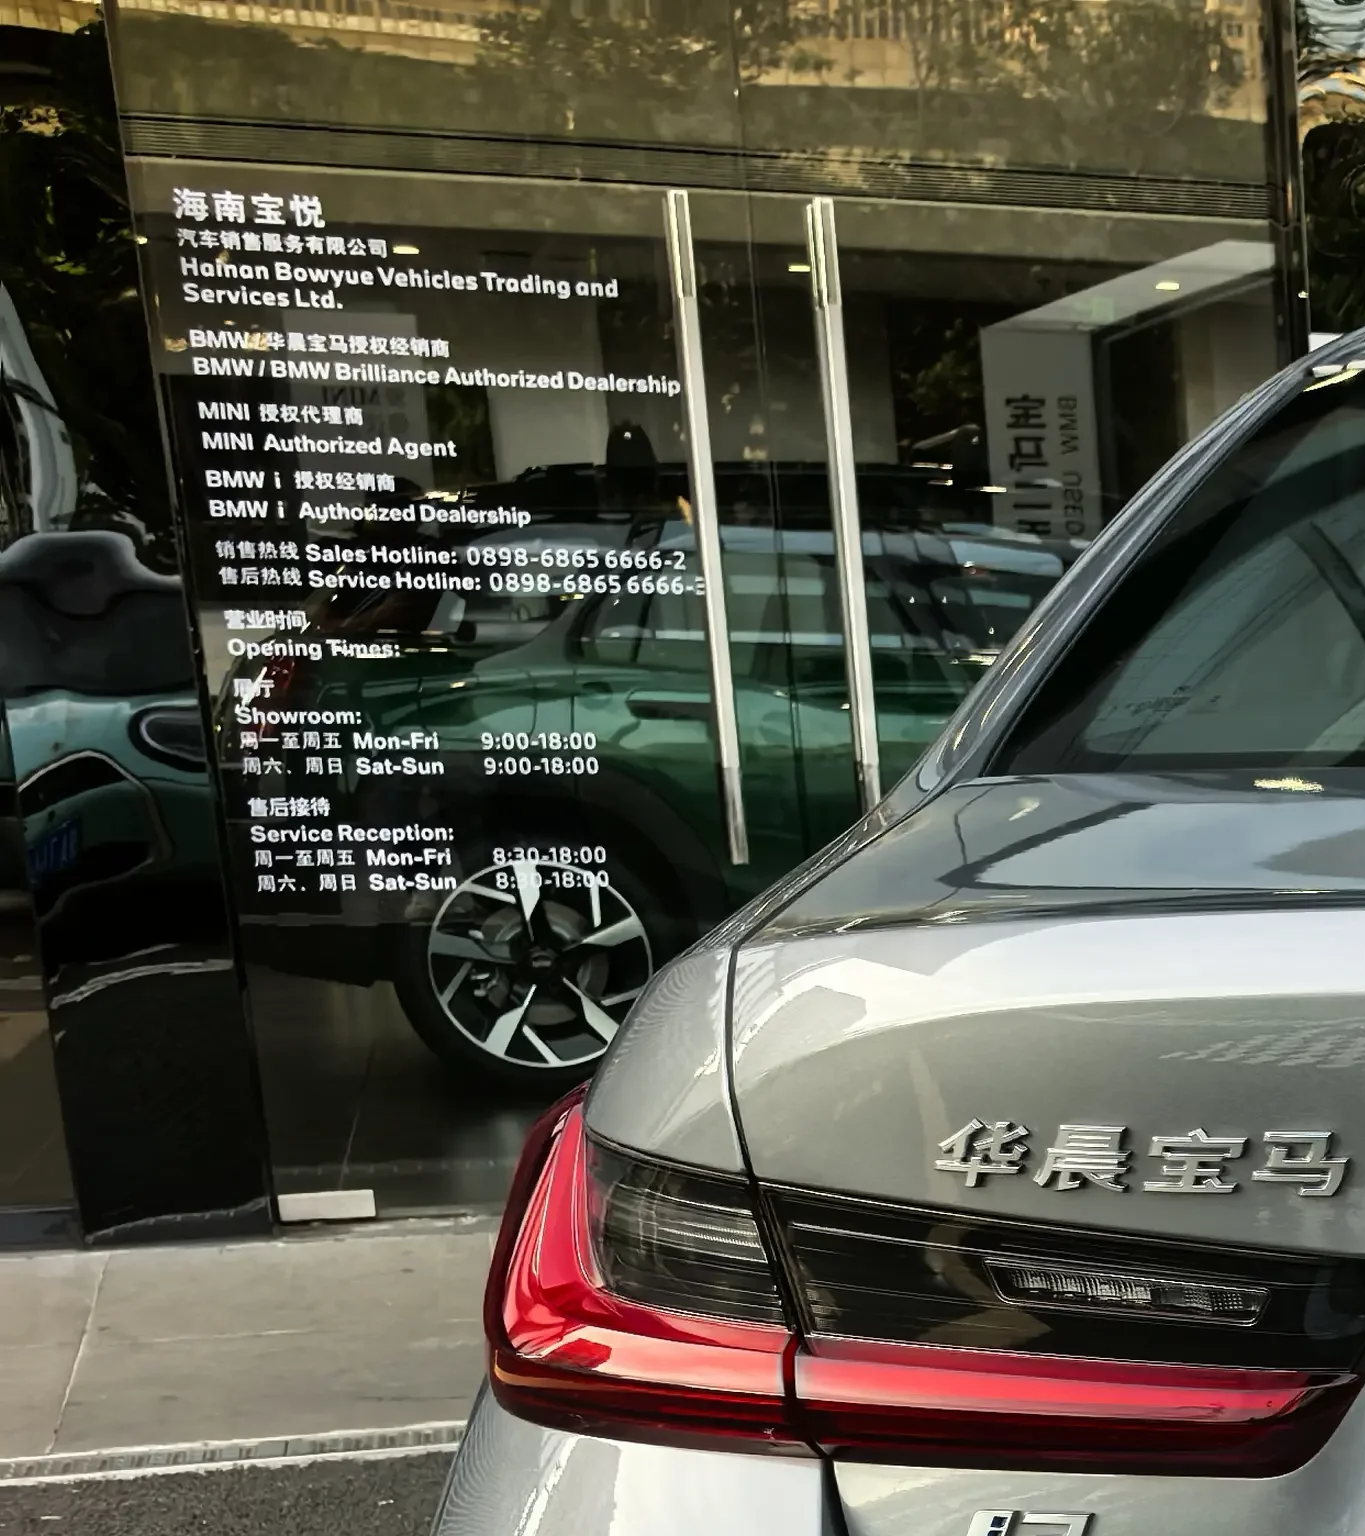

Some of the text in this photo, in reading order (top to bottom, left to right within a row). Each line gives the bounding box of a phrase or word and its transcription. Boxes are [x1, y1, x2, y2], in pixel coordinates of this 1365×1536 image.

[172, 187, 326, 228] 海南宝悦
[177, 228, 388, 259] 汽车销售服务有限公司
[180, 255, 619, 299] Hainan Bowyue Vehicles Trading and
[183, 283, 344, 310] Services Ltd.
[192, 357, 681, 397] BMW / BMW Brilliance Authorized Dealership
[197, 401, 252, 421] MINI
[259, 403, 364, 426] 授权代理商
[201, 431, 457, 460] MINI Authorized Agent
[205, 469, 395, 493] BMW i 授权经销商
[209, 499, 268, 518] BMW
[277, 501, 285, 519] i
[420, 504, 532, 528] Dealership
[215, 540, 687, 571] 销售热线 Sales Hotline: 0898-6865 6666-2
[218, 566, 302, 586] 售后热线
[308, 570, 391, 590] Service
[395, 571, 481, 591] Hotline:
[489, 573, 621, 594] 0898-6865
[224, 610, 308, 630] 营业时间
[227, 638, 400, 661] Opening Times:
[236, 707, 362, 725] Showroom:
[239, 731, 597, 751] 周一至周五 Mon-Fri 9:00-18:00
[355, 757, 445, 776] Sat-Sun
[483, 756, 600, 775] 9:00-18:00
[247, 796, 331, 817] 售后接待
[250, 823, 454, 845] Service Reception:
[254, 846, 607, 868] 周一至周五 Mon-Fri 8:30-18:00
[368, 873, 458, 892] Sat-Sun
[934, 1117, 1353, 1198] 华晨宝马
